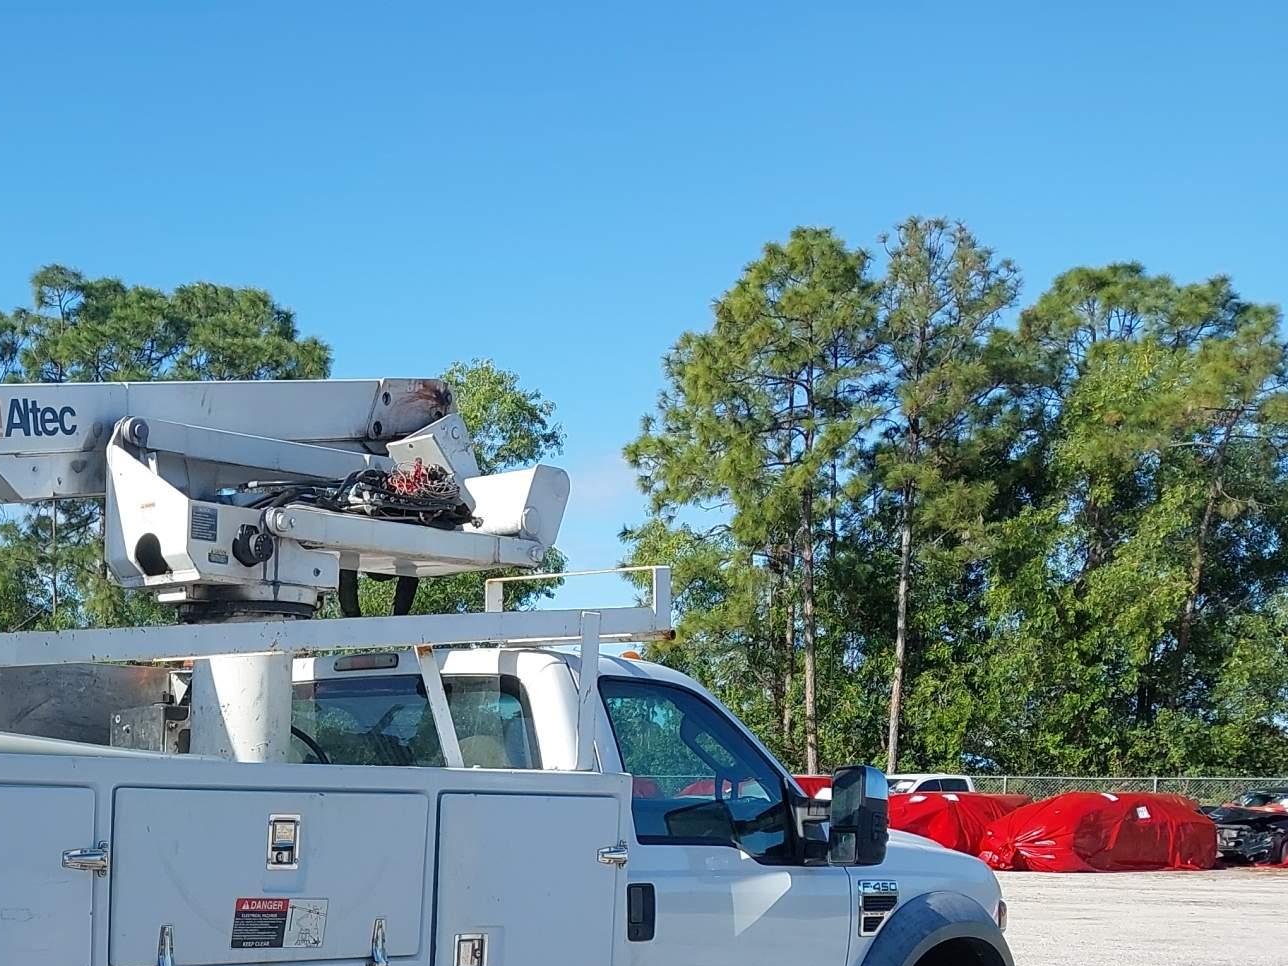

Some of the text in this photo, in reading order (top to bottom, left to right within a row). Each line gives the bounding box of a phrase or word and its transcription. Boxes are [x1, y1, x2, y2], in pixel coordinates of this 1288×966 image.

[5, 398, 77, 437] Altec
[862, 882, 897, 892] F-450
[250, 900, 283, 910] DANGER
